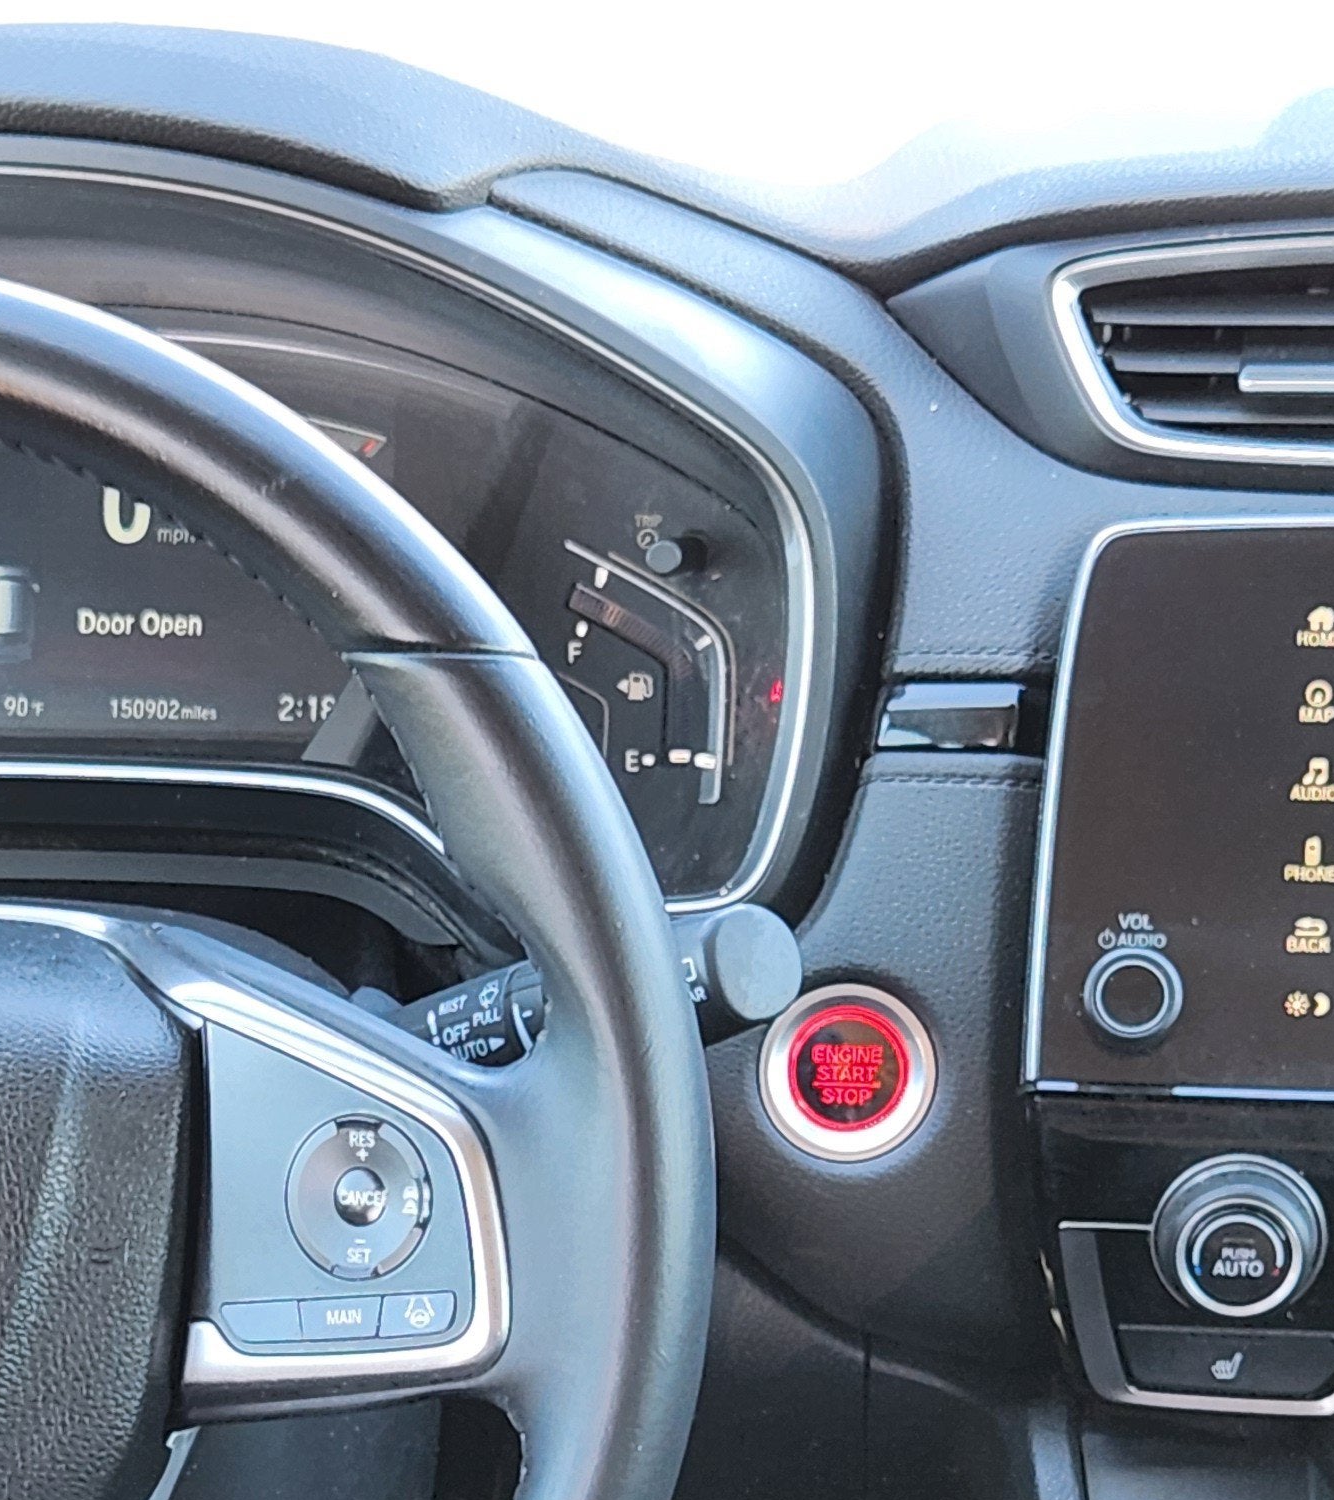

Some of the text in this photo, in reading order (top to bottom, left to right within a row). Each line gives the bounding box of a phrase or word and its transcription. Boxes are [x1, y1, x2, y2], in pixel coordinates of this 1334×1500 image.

[633, 513, 663, 528] TRIP
[77, 608, 204, 639] Door Open
[567, 640, 583, 665] F
[623, 748, 640, 773] E
[1117, 912, 1154, 932] VOL
[1116, 932, 1167, 949] AUDIO
[1285, 935, 1332, 954] BACK
[442, 1021, 470, 1046] OFF
[811, 1043, 884, 1065] ENGINE
[816, 1064, 879, 1082] START
[821, 1088, 873, 1106] STOP
[348, 1130, 376, 1149] RES
[346, 1248, 371, 1264] SET
[1212, 1259, 1265, 1278] AUTO
[326, 1308, 362, 1326] MAIN
